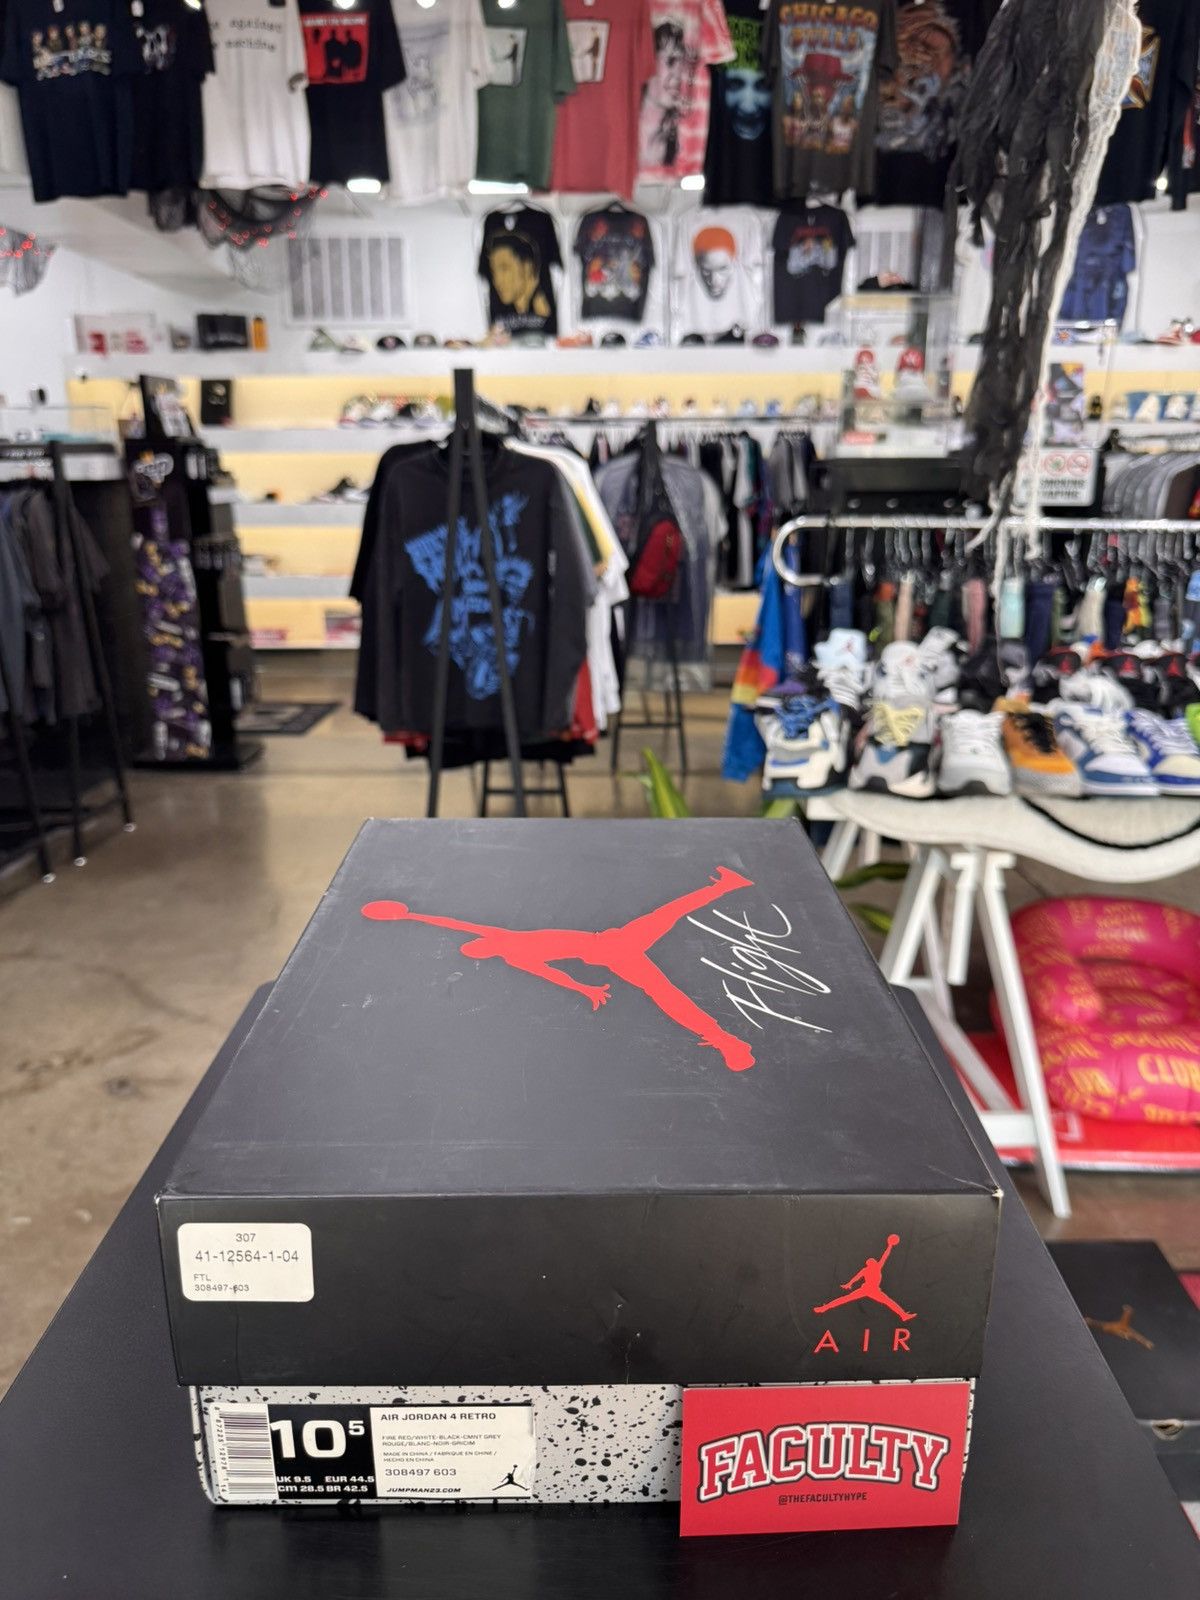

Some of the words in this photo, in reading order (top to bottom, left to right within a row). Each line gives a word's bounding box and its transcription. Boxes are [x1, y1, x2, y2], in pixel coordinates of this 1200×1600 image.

[779, 3, 878, 31] CHICAGO
[235, 1233, 256, 1242] 307
[195, 1250, 299, 1262] 41-12564-1-04
[193, 1274, 211, 1282] FTL
[194, 1284, 249, 1292] 308497-603
[380, 1413, 399, 1421] AIR
[402, 1413, 447, 1421] JORDAN
[697, 1421, 951, 1502] FACULTY
[385, 1468, 430, 1476] 308497
[433, 1468, 457, 1476] 603
[276, 1475, 292, 1483] UK
[294, 1475, 311, 1483] 9.5
[325, 1475, 347, 1483] EUR
[349, 1475, 375, 1483] 44.5
[343, 1484, 368, 1492] 42.5
[778, 1492, 867, 1505] @THEFACULTYHYPE
